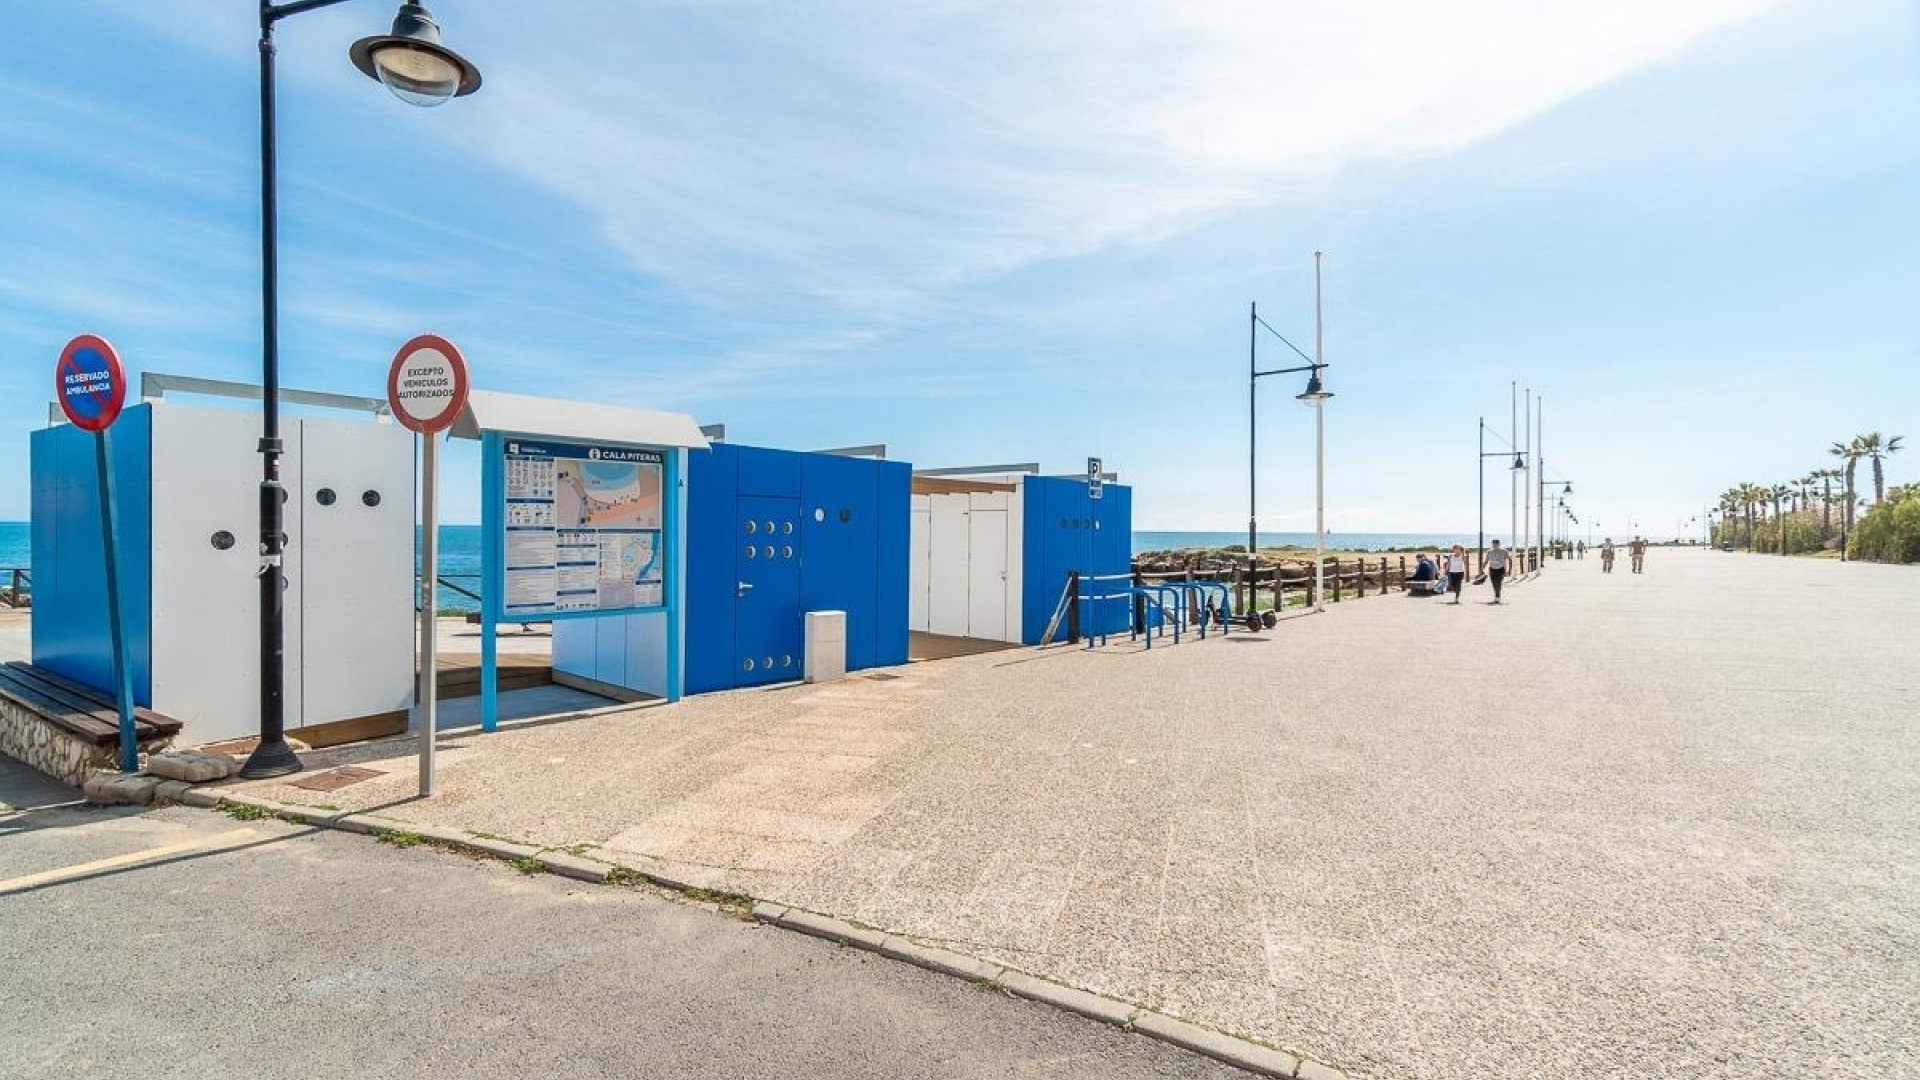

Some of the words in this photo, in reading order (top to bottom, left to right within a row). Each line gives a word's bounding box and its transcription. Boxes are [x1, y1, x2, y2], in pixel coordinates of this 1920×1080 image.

[65, 370, 110, 384] RESERVADO
[407, 366, 444, 377] EXCEPTO
[66, 382, 110, 395] AMBULANCIA
[398, 389, 456, 398] AUTORIZADOS
[627, 452, 661, 463] PITERAS
